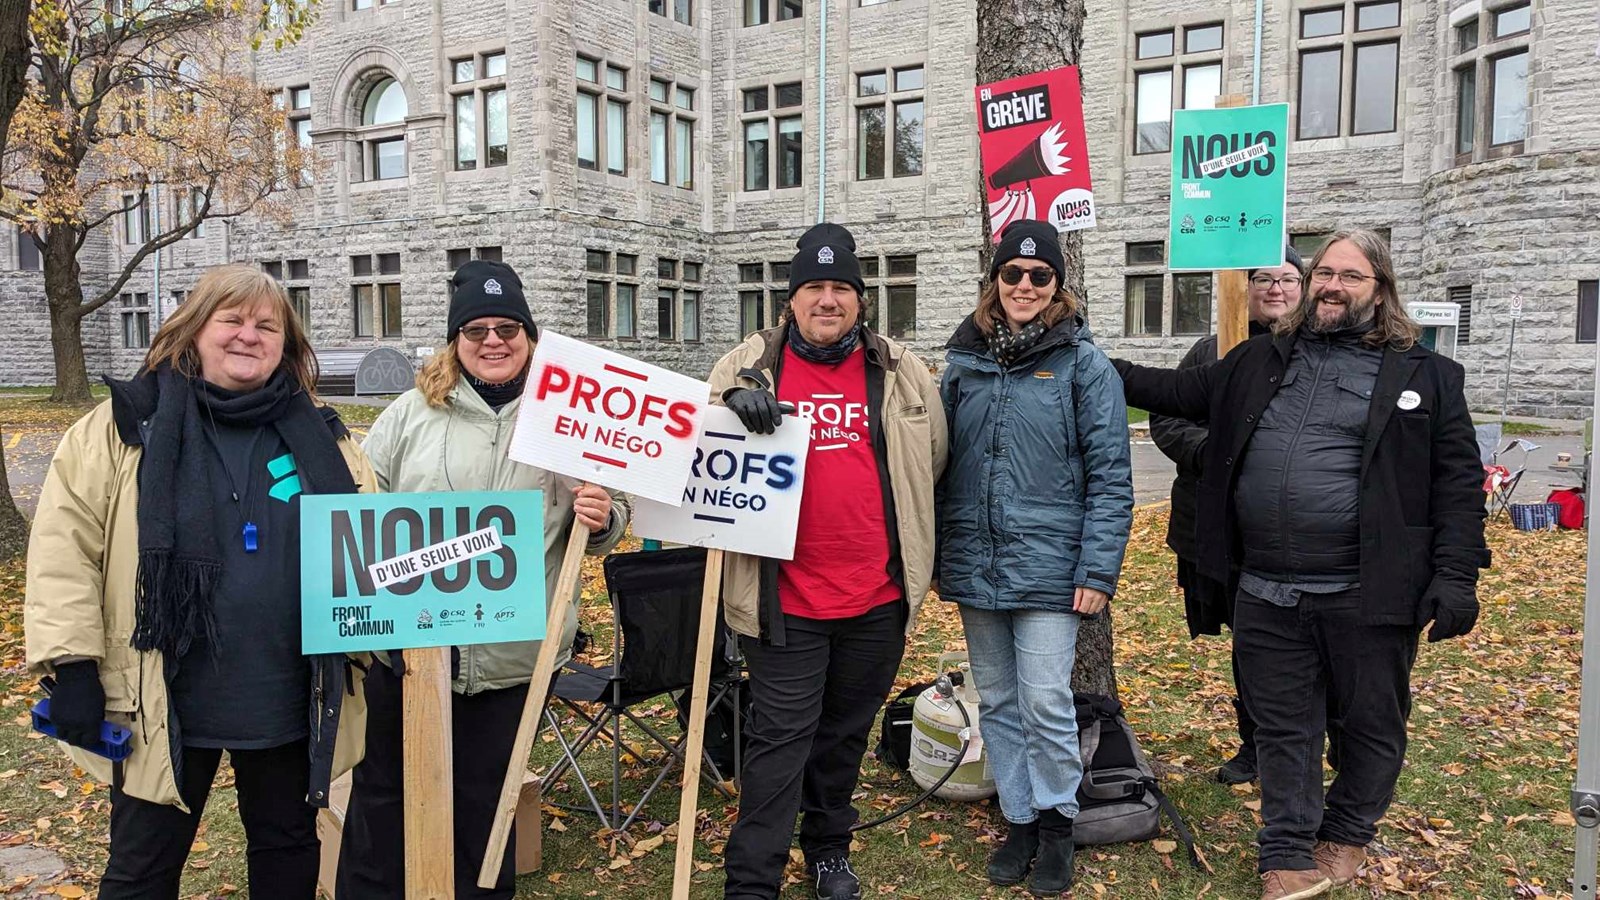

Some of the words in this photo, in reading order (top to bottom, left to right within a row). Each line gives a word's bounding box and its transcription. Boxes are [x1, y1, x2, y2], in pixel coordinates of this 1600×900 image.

[980, 87, 992, 101] EN
[986, 92, 1047, 129] GRÈVE
[1181, 130, 1276, 179] NOUS
[1203, 160, 1224, 173] D'UNE
[1225, 153, 1246, 165] SEULE
[1248, 144, 1265, 157] VOIX
[1056, 199, 1091, 221] NOUS
[1253, 218, 1272, 226] APTS
[536, 364, 697, 439] PROFS
[778, 400, 868, 428] ROF
[554, 414, 588, 440] EN
[594, 427, 662, 458] NÉGO
[809, 428, 816, 440] N
[821, 426, 860, 442] NÉGO
[691, 446, 796, 490] ROFS
[682, 486, 696, 503] N
[702, 486, 767, 512] NÉGO
[331, 504, 518, 598] NOUS
[376, 557, 418, 583] D'UNE
[420, 543, 461, 568] SEULE
[463, 532, 495, 554] VOIX
[332, 605, 372, 622] FRONT
[493, 611, 515, 620] APTS
[339, 619, 394, 638] COMMUN
